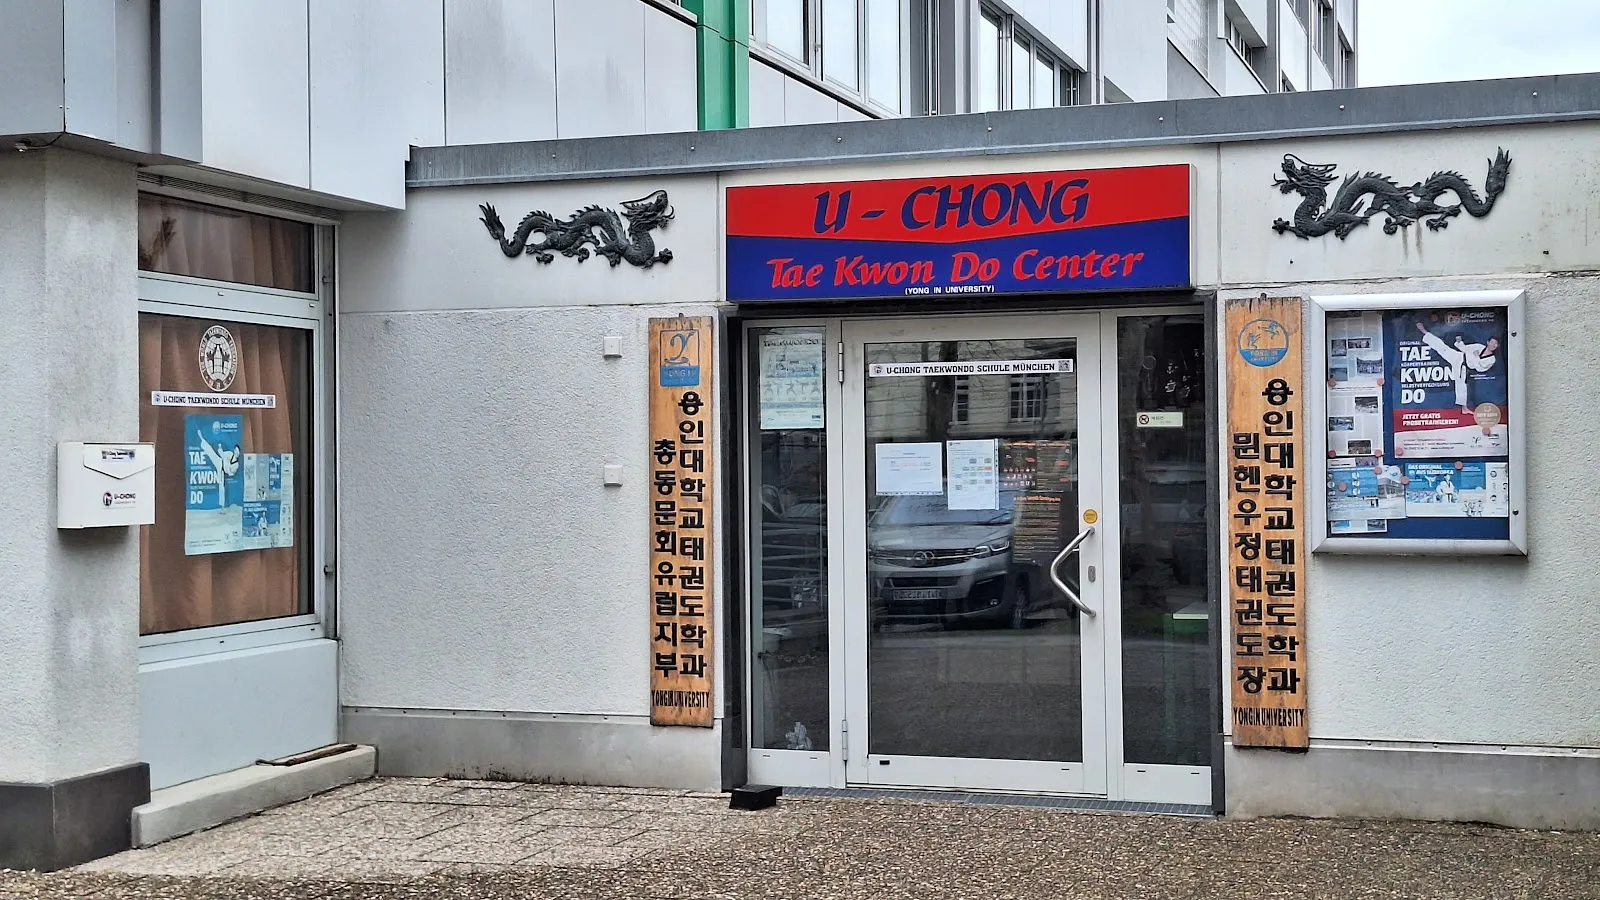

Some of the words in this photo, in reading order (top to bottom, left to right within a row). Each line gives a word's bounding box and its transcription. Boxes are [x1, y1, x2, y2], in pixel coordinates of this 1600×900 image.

[813, 190, 852, 234] U
[901, 178, 1089, 230] CHONG
[766, 257, 824, 289] Tae
[833, 254, 934, 286] Kwon
[950, 250, 1000, 281] Do
[1012, 248, 1144, 280] Center
[905, 287, 929, 295] (YONG
[933, 286, 942, 294] IN
[945, 285, 995, 293] UNIVERSITY)
[1400, 346, 1431, 361] TAE
[886, 366, 921, 374] U-CHONG
[924, 365, 974, 373] TAEKWONDO
[977, 364, 1010, 372] SCHULE
[1012, 362, 1055, 371] MÜNCHEN
[1401, 366, 1455, 383] KWON
[187, 396, 219, 404] TAEKWONDO
[1401, 389, 1425, 404] DO
[189, 451, 207, 465] TAE
[190, 471, 219, 485] KWON
[190, 490, 204, 505] DO
